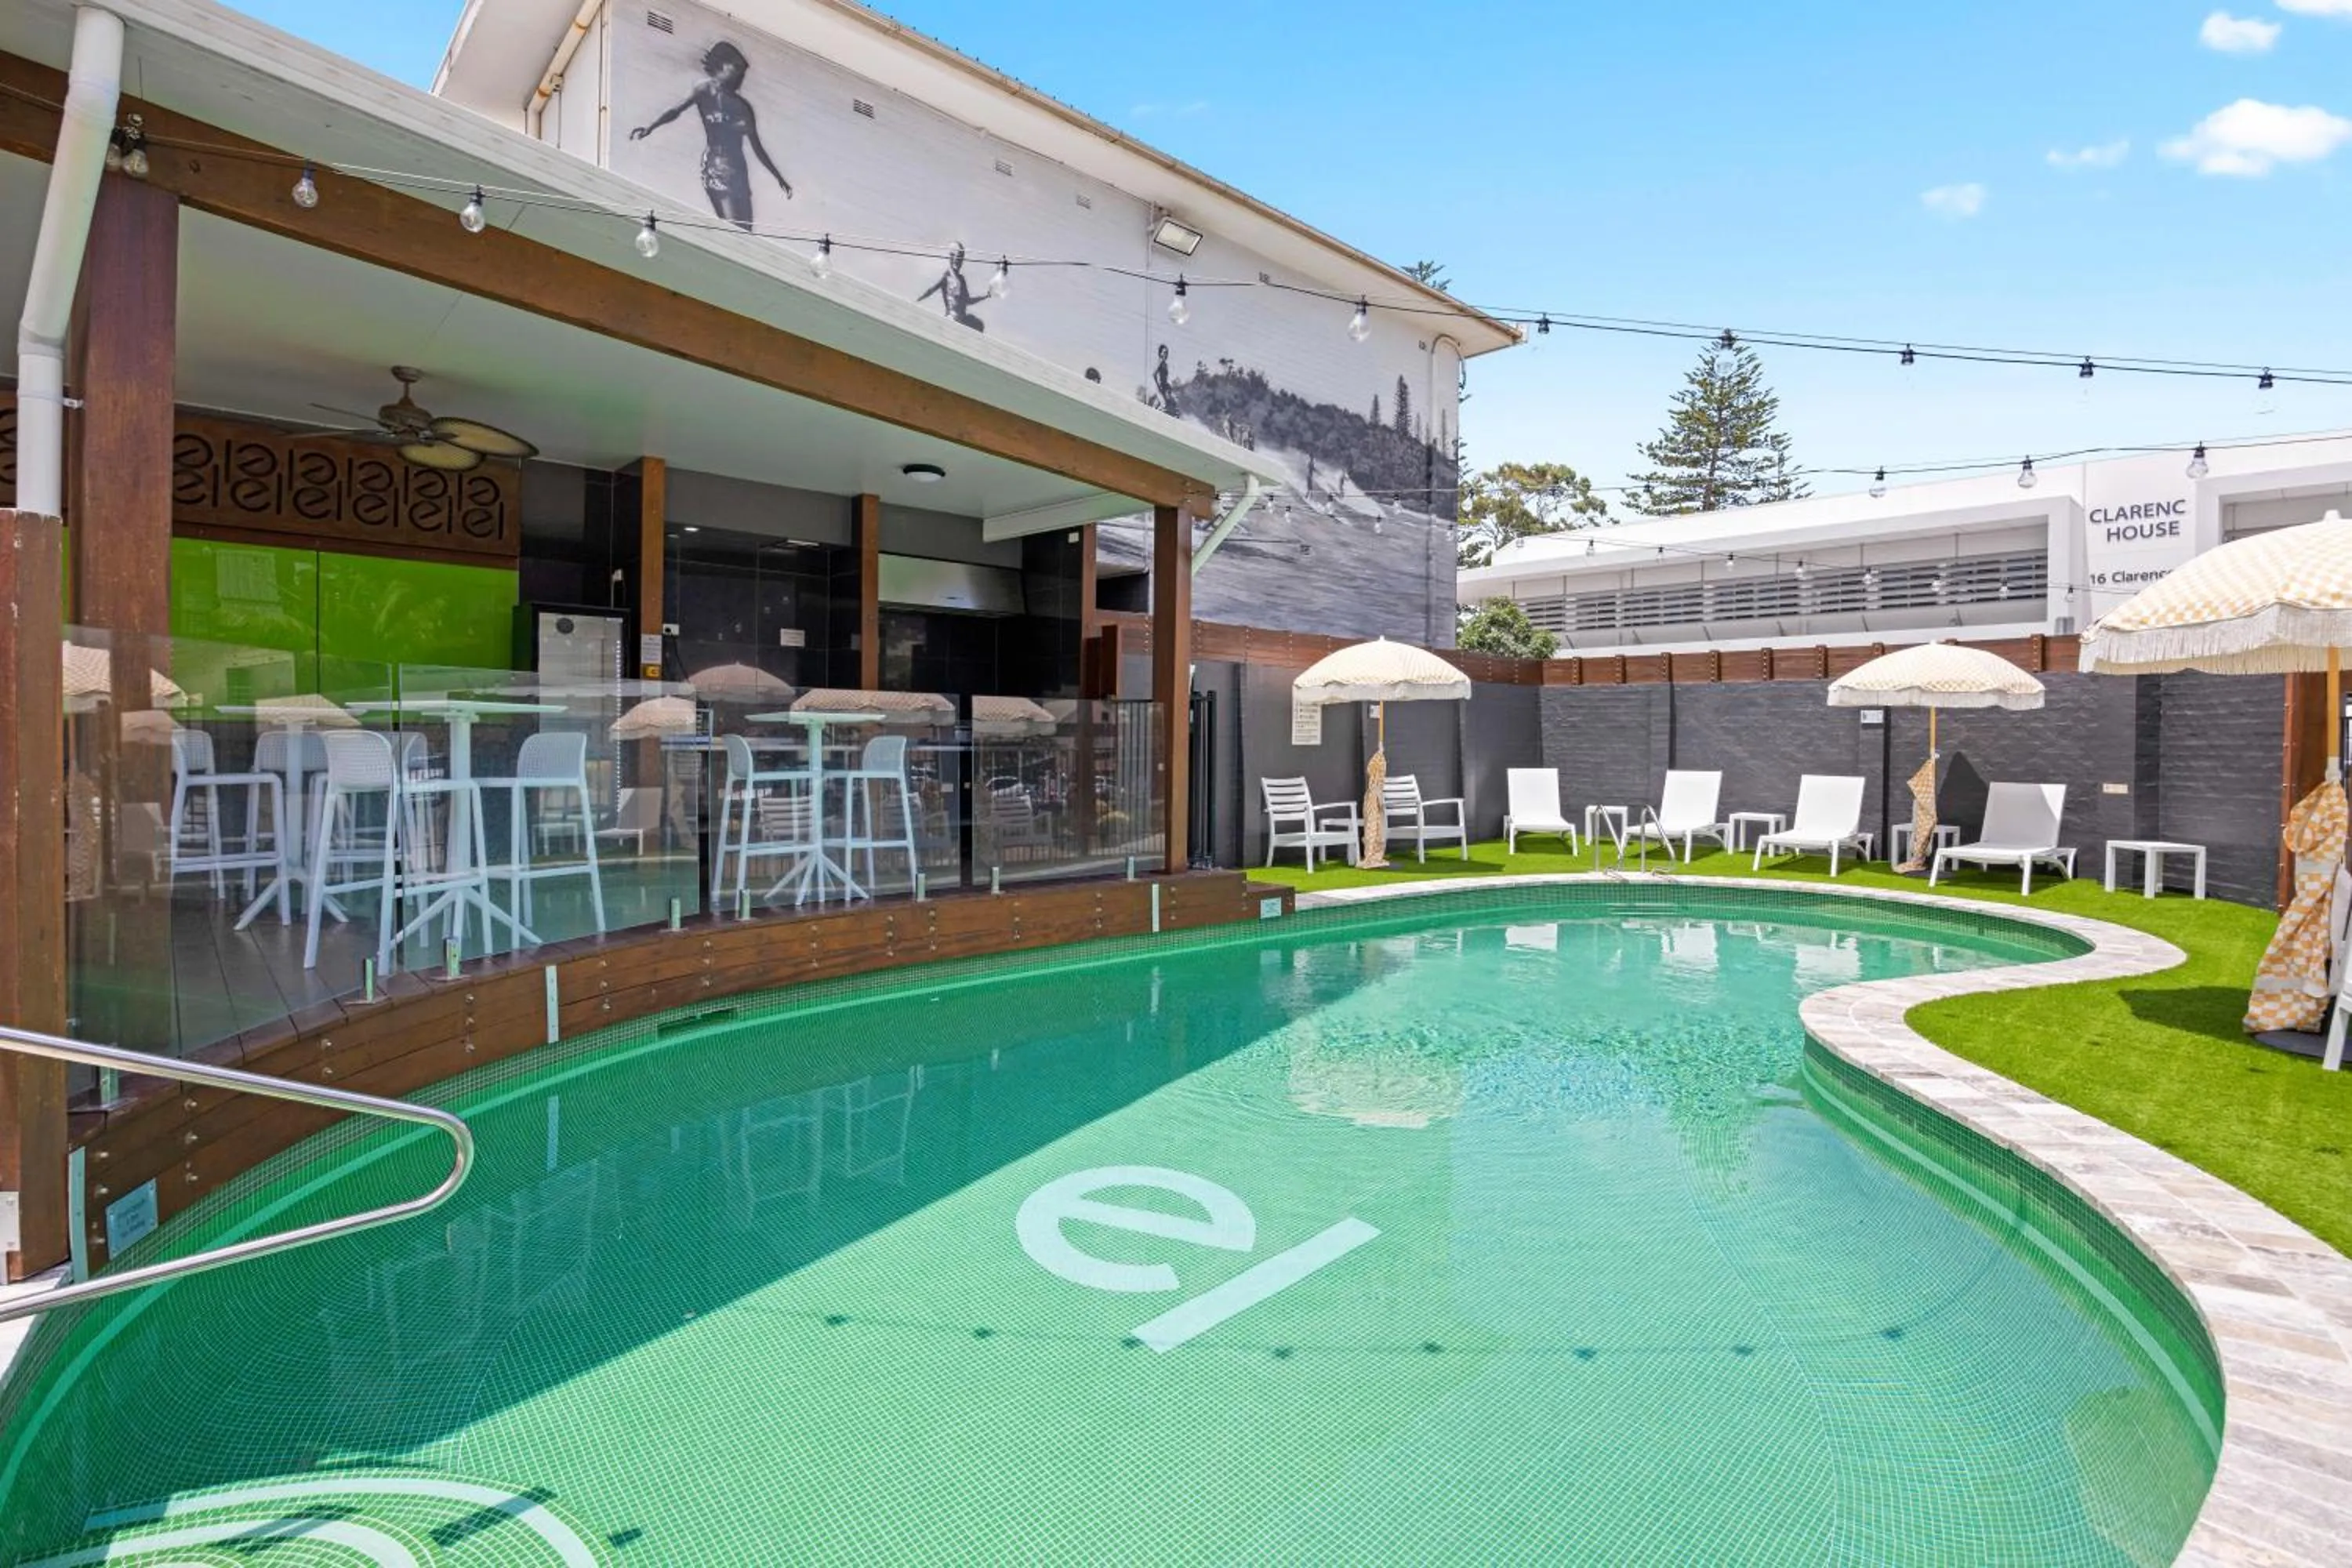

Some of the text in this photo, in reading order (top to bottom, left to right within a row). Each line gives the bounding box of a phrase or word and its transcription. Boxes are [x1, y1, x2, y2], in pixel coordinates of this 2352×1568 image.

[2089, 499, 2187, 524] CLARENC
[2107, 521, 2180, 543] HOUSE
[2089, 570, 2173, 584] 16 Clarenc
